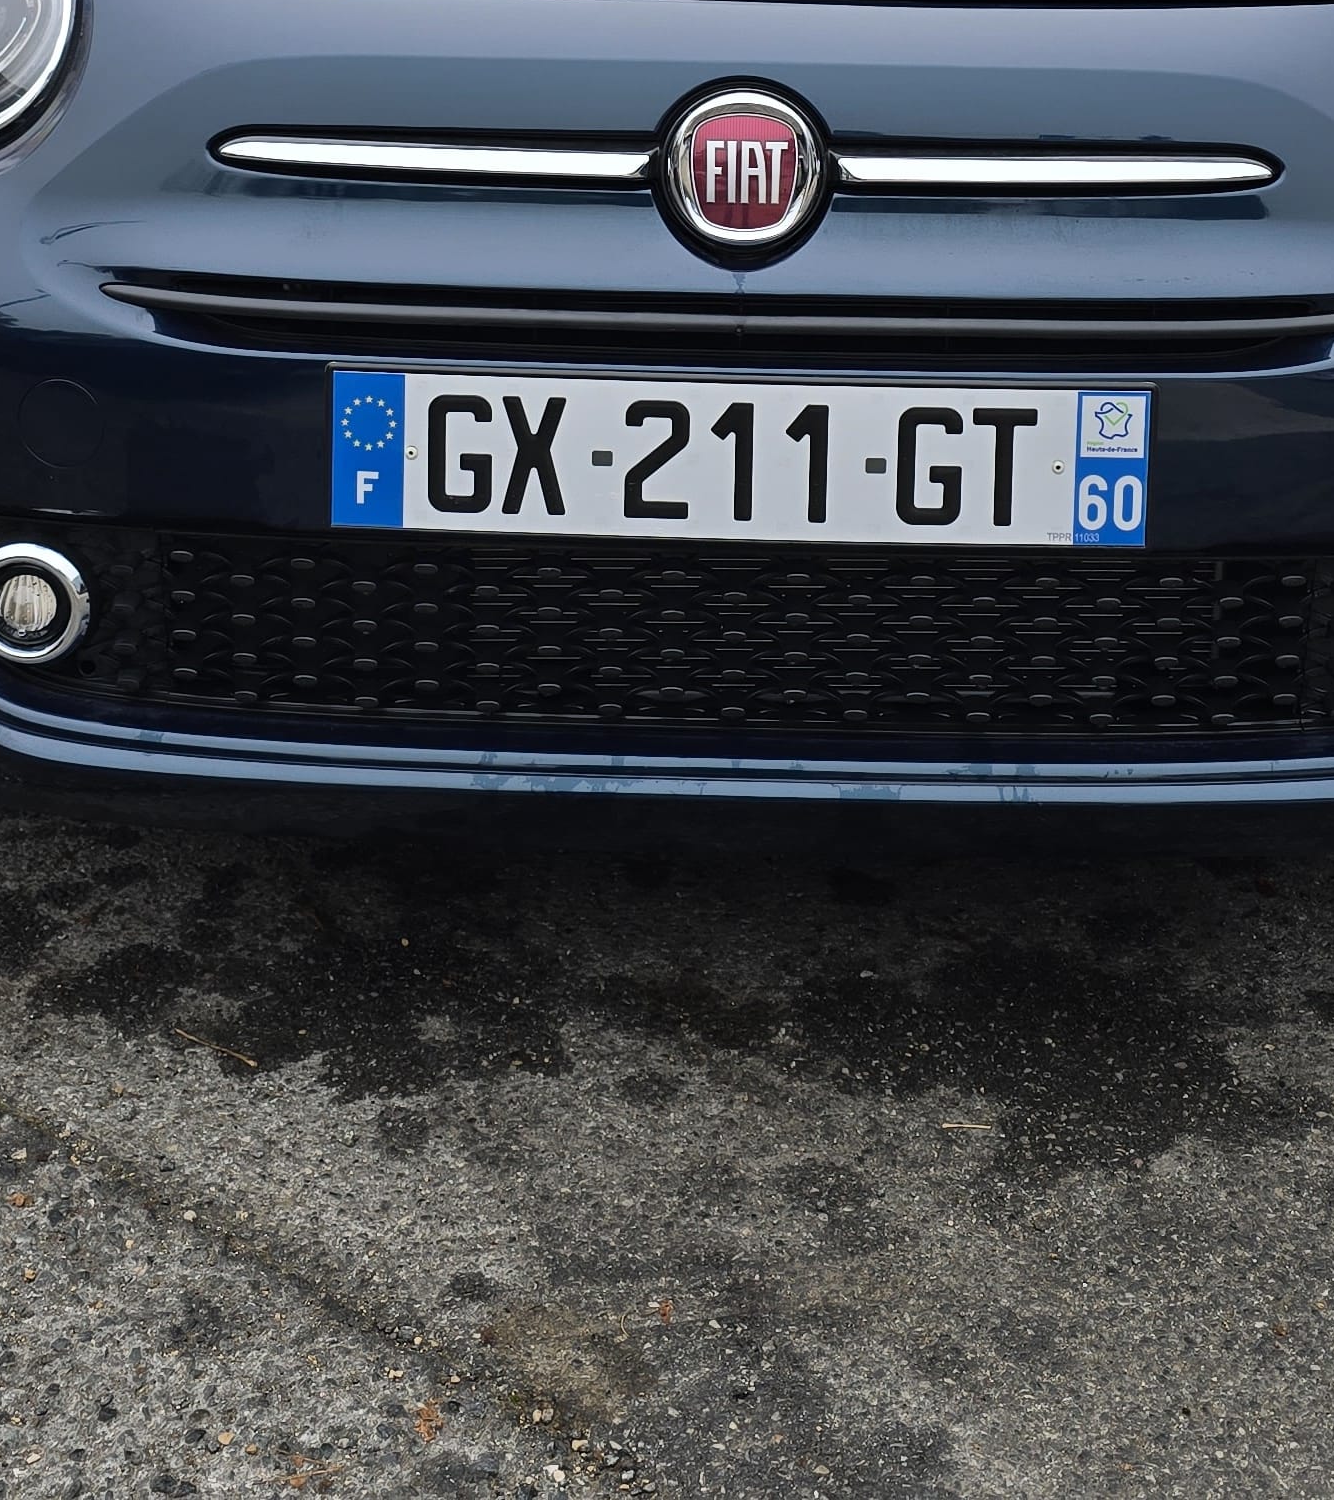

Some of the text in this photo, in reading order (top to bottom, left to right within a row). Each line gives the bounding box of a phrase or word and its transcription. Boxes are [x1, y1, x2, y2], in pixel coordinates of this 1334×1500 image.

[706, 139, 789, 204] FIAT
[356, 470, 380, 504] F
[428, 394, 1037, 527] GX-211-GT
[1078, 474, 1144, 532] 60
[1047, 532, 1072, 542] TPPR
